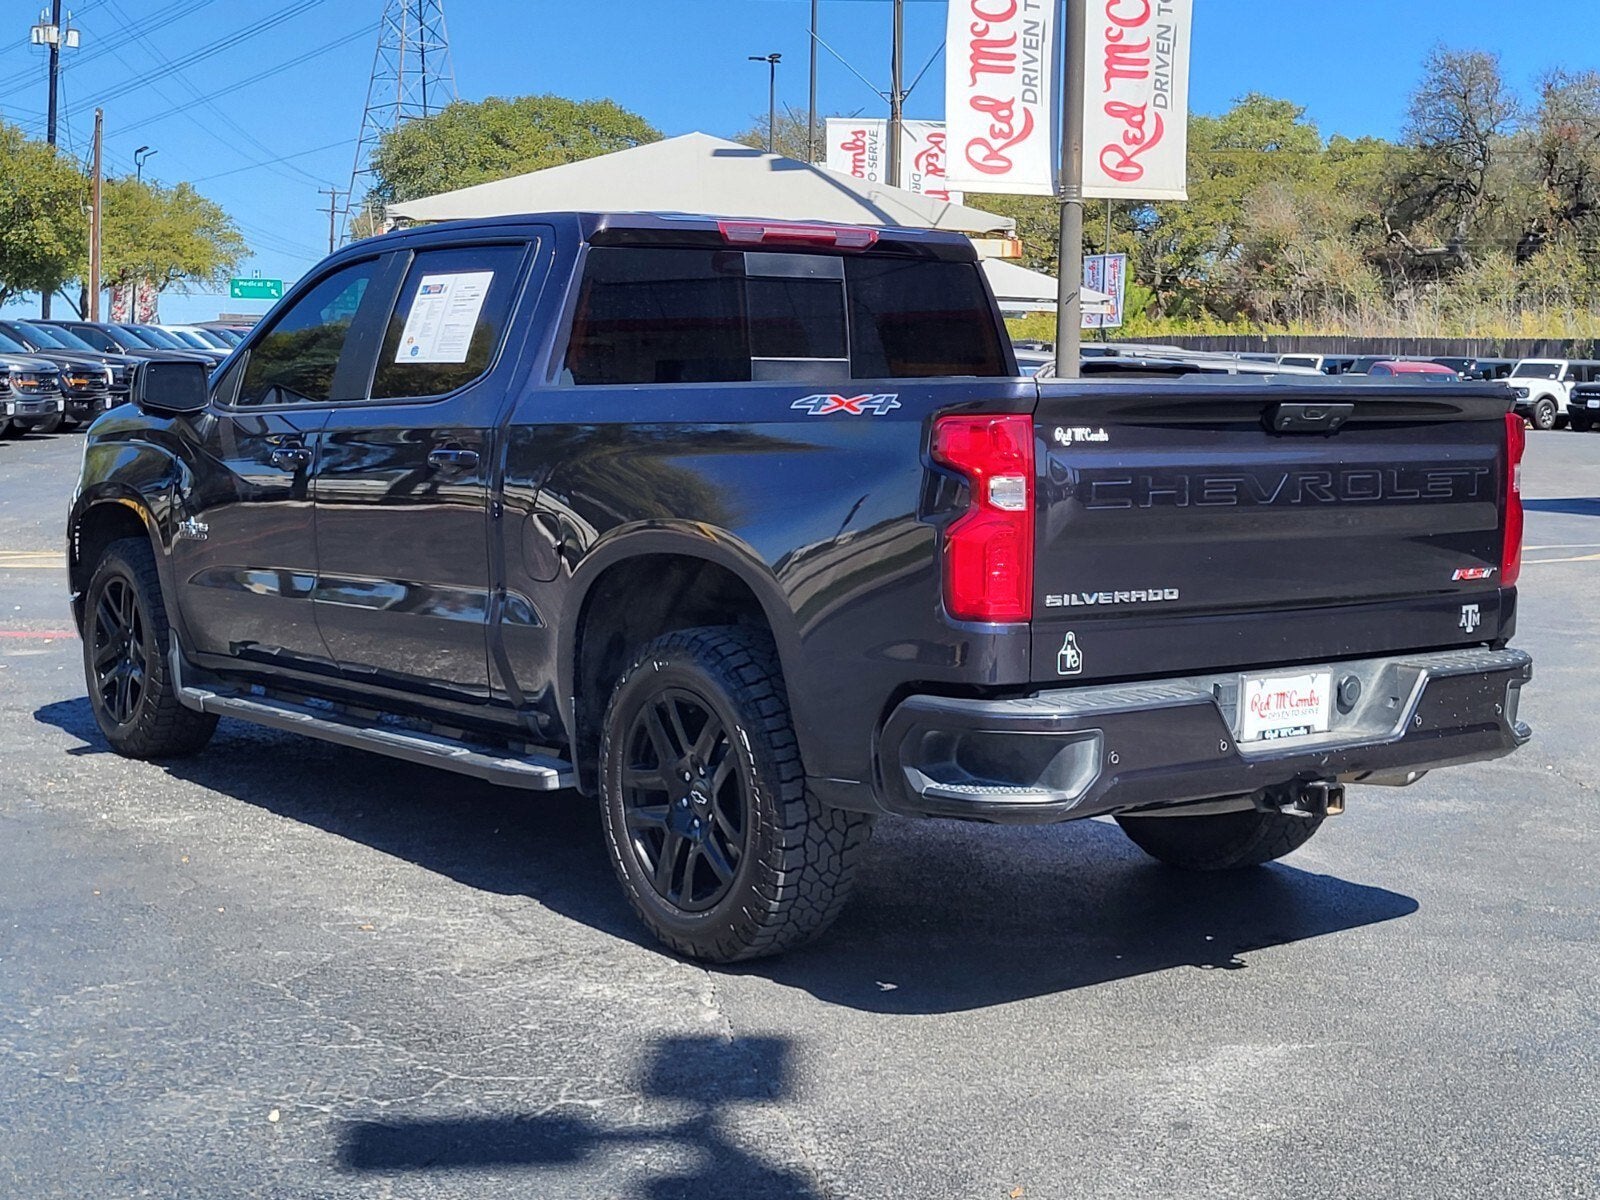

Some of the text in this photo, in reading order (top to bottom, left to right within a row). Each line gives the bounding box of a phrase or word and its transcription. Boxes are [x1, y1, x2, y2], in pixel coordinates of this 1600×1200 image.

[1021, 0, 1041, 105] DRIVEN T
[1153, 24, 1173, 110] DRIVEN
[1099, 0, 1164, 182] Red McC
[840, 130, 867, 179] ombs
[868, 129, 879, 182] O SERVE
[965, 95, 1034, 175] Red
[912, 173, 922, 194] DRI
[1054, 426, 1072, 446] Red
[1085, 467, 1490, 510] CHEVROLET
[1451, 567, 1498, 581] RST
[1045, 588, 1180, 607] SILVERADO
[1251, 689, 1320, 718] Red McCombs
[1267, 707, 1319, 720] DRIVEN TO SERVE
